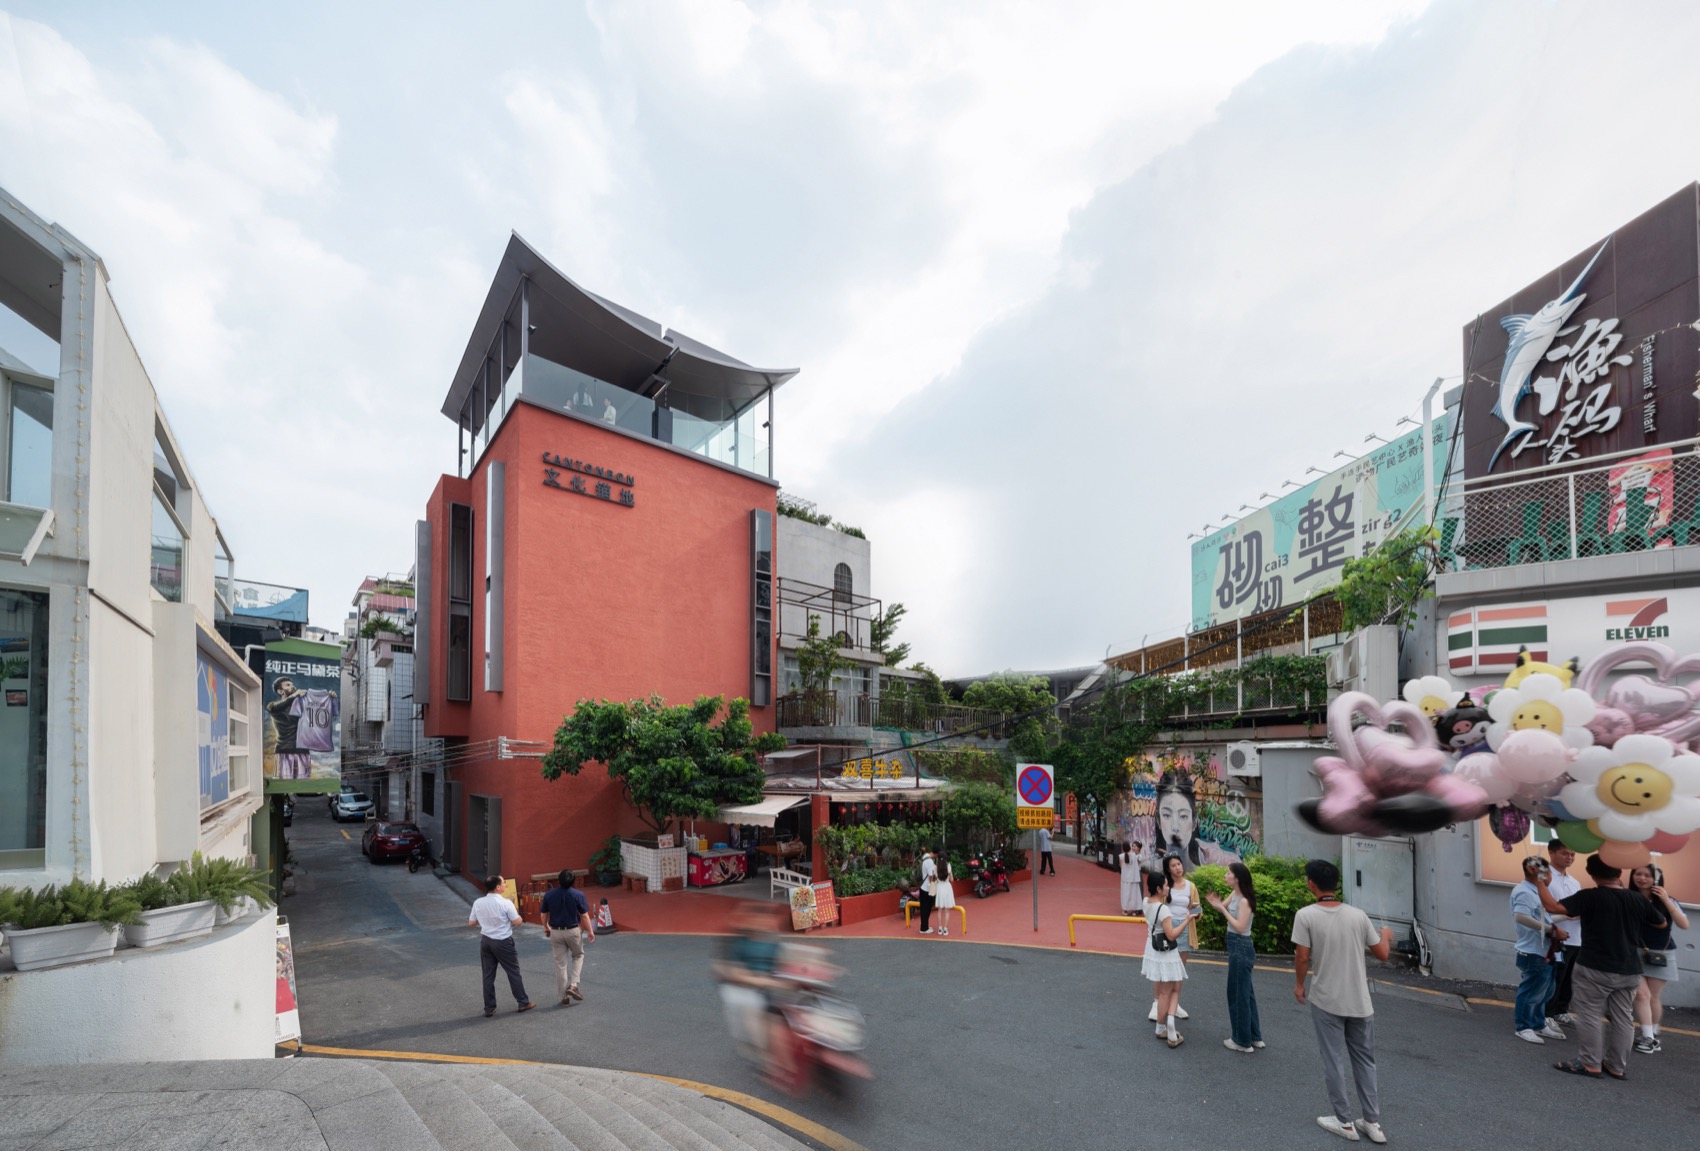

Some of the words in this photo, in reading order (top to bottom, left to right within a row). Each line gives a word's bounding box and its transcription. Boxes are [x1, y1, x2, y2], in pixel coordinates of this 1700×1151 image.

[1644, 401, 1656, 433] Wharf
[1406, 423, 1443, 449] 渔人头
[1293, 485, 1355, 584] 整
[1264, 553, 1290, 574] cai3
[265, 660, 340, 678] 纯正马黛茶
[306, 707, 331, 728] 10
[842, 758, 903, 779] 双喜牛杂
